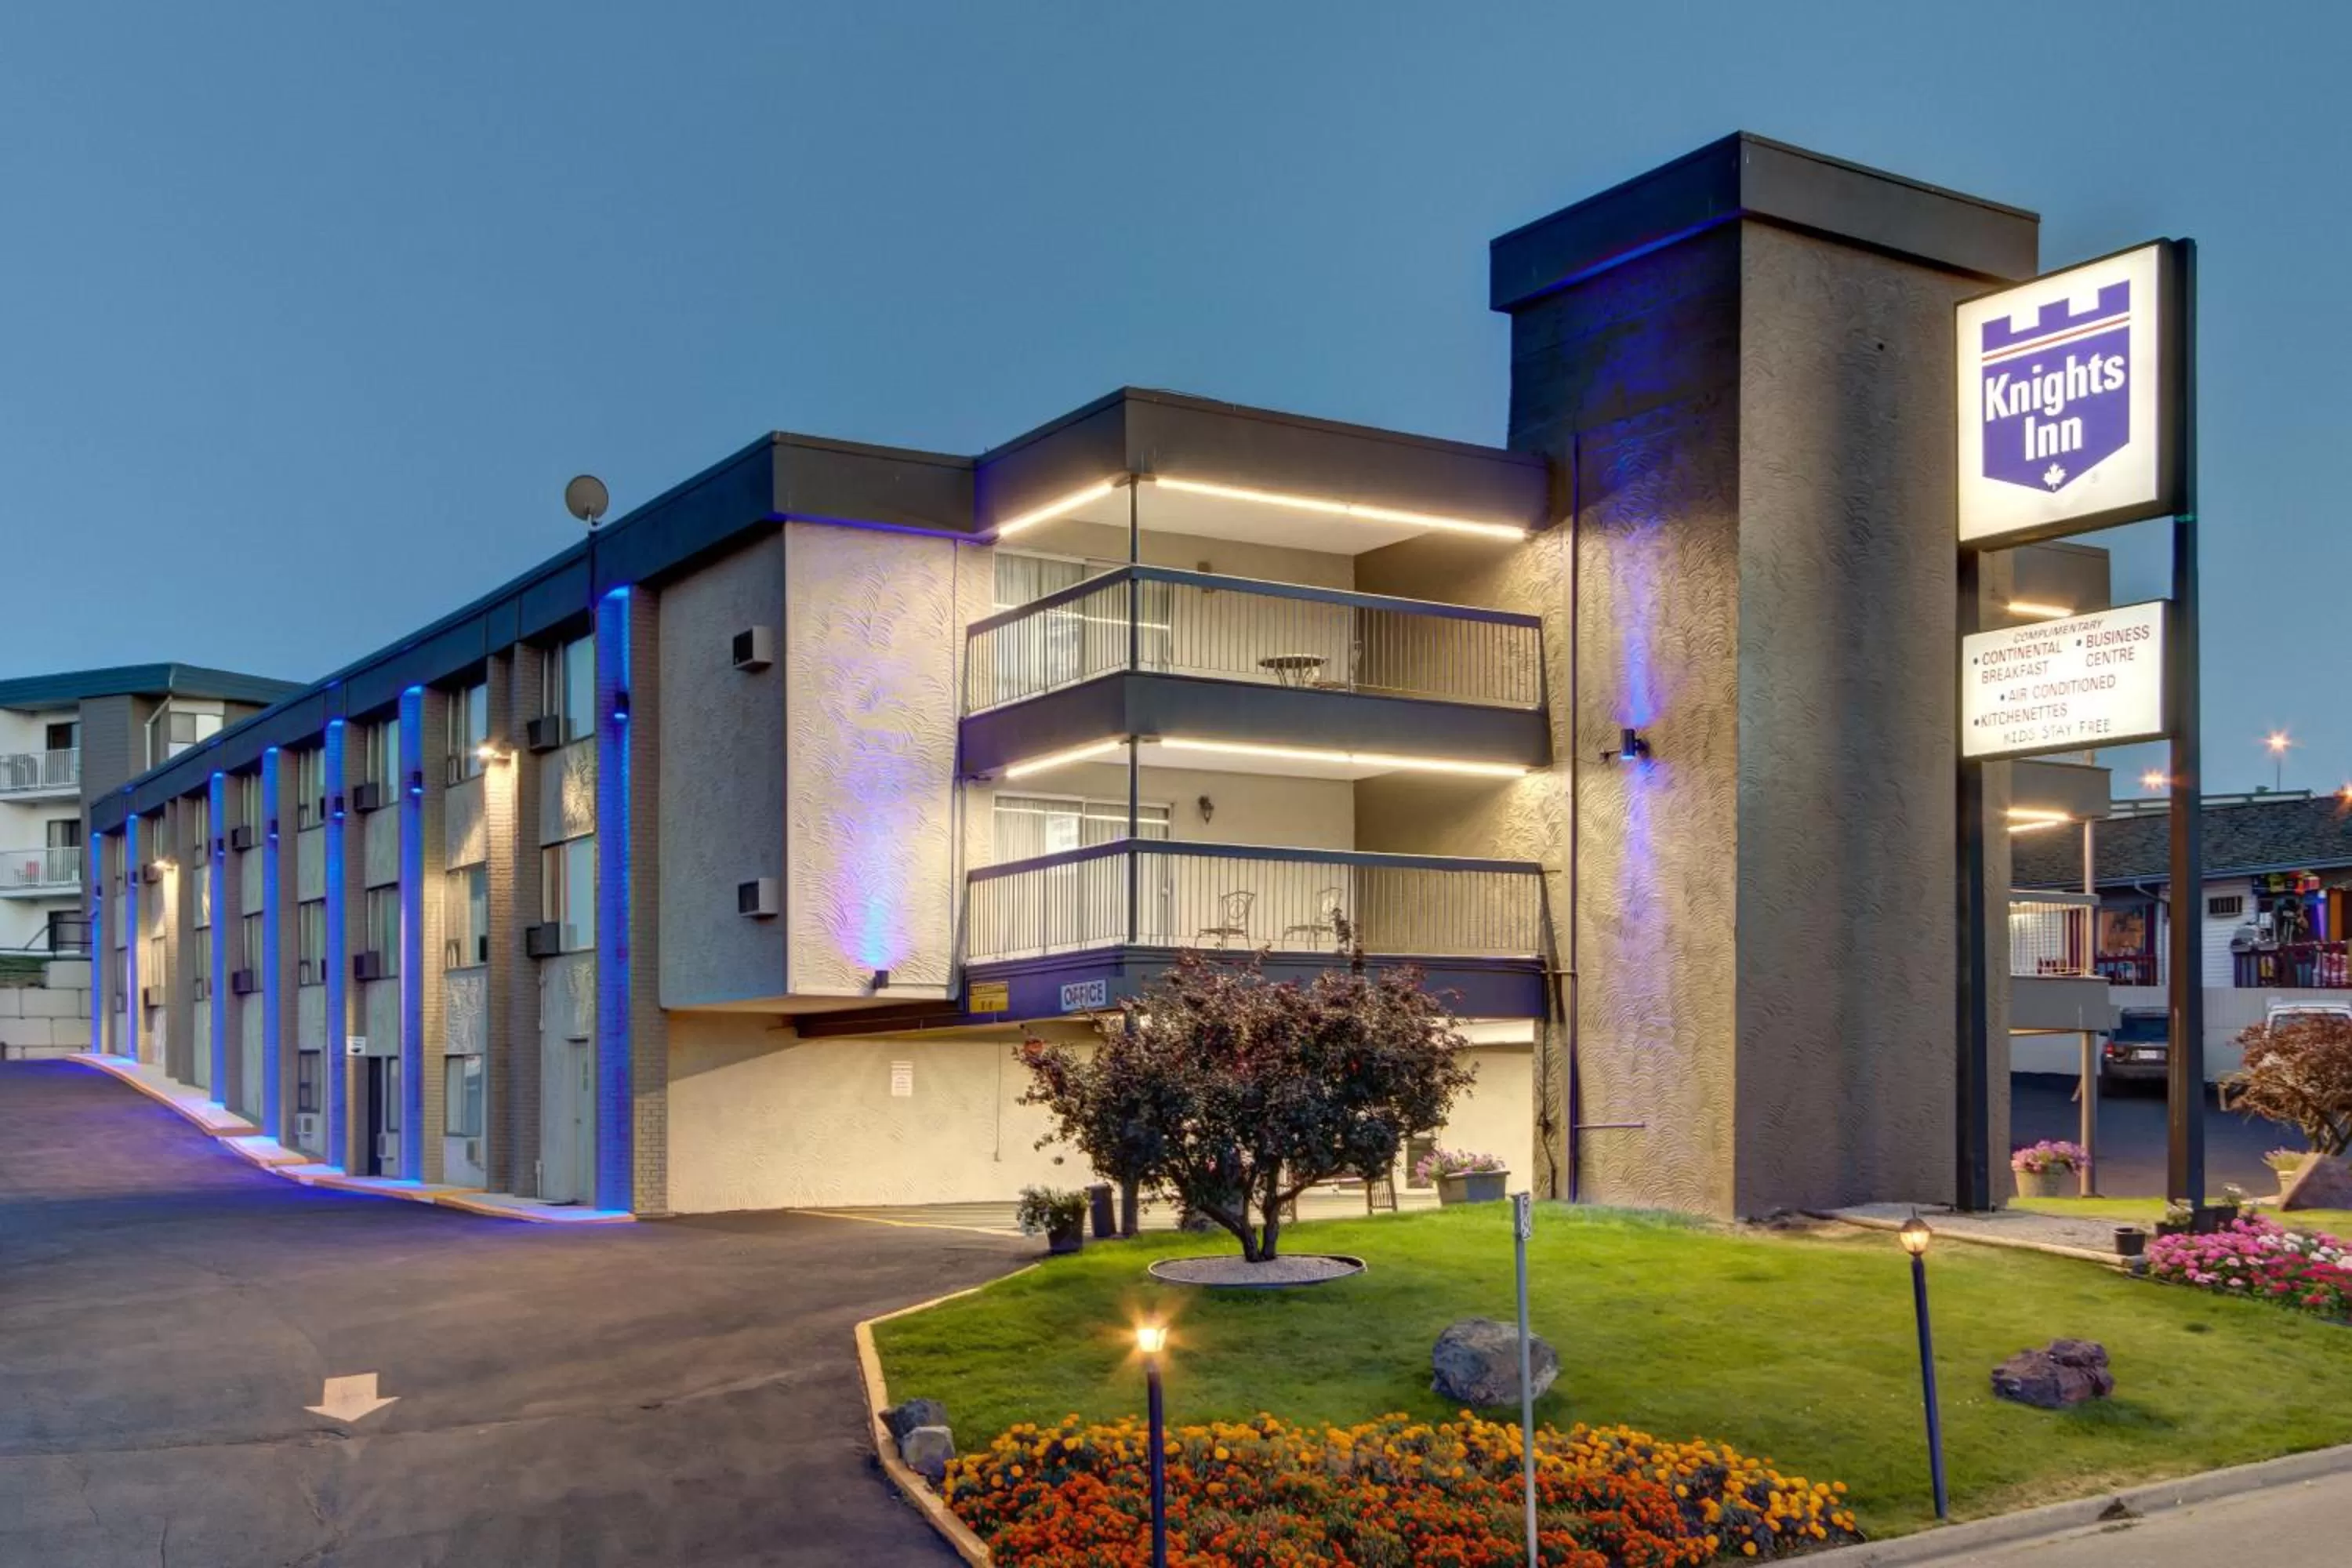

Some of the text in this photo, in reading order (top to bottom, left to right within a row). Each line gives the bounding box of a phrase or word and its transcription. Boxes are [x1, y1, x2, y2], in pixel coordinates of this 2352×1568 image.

[1985, 352, 2125, 422] Knights
[2025, 416, 2083, 461] Inn
[2086, 625, 2151, 649] BUSINESS
[1982, 639, 2063, 666] CONTINENTAL
[2085, 646, 2135, 668] CENTRE
[1981, 660, 2049, 684] BREAKFAST
[2009, 673, 2116, 702] AIR CONDITIONED
[1980, 702, 2068, 728] KITCHENETTES
[2042, 724, 2072, 740] STAY
[2079, 717, 2111, 734] FREE
[1064, 982, 1103, 1005] OFFICE
